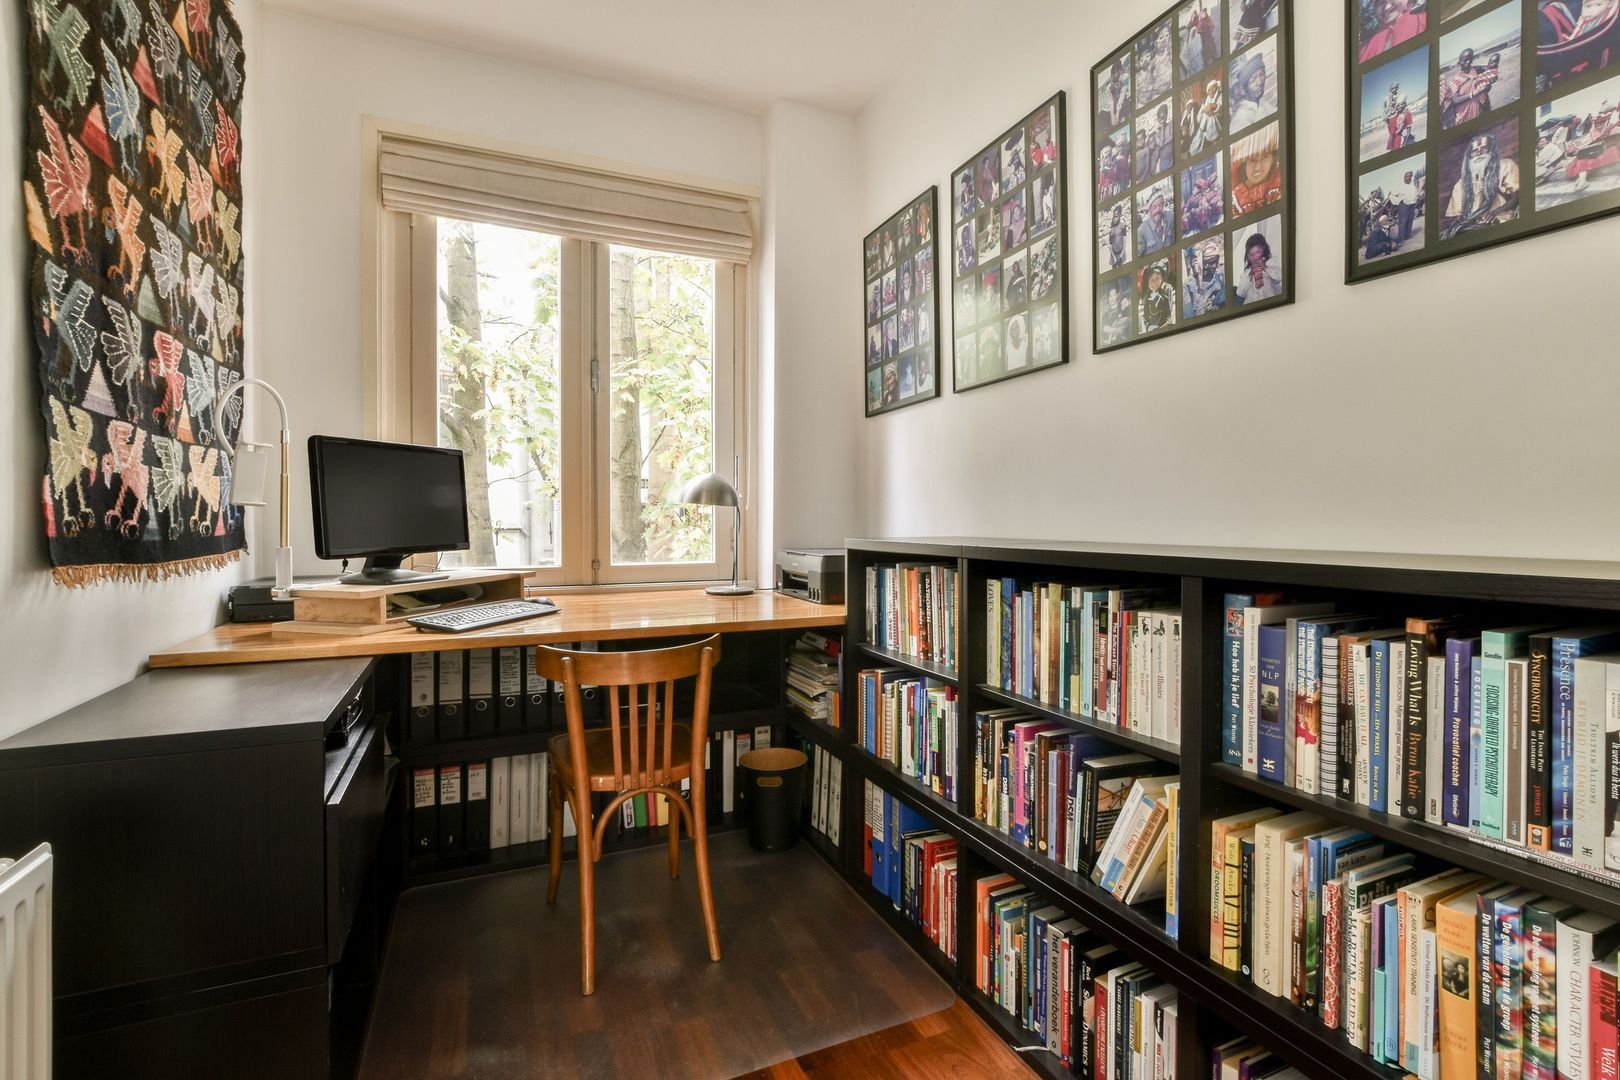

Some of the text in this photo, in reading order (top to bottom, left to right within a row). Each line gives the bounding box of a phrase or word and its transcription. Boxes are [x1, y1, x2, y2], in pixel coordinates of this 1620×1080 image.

[1230, 641, 1241, 708] Hoe heb ik je lief
[1262, 670, 1280, 680] NLP
[1531, 650, 1547, 724] SYNCHRONICITY
[1559, 642, 1576, 700] Presence
[1248, 665, 1256, 752] 50 Psychologie klassiekers
[1406, 640, 1422, 798] Loving What Is Byron Katie
[1577, 700, 1586, 746] BEVRIJD
[1452, 717, 1461, 786] Provocatief coachen
[1486, 684, 1498, 796] FOCUSING-ORIENTED PSYCHOTHERAPY
[1590, 722, 1598, 804] TSULTRIM ALLIONE
[1576, 763, 1586, 820] DEMONEN
[1136, 815, 1146, 829] Am
[1264, 834, 1272, 956] Jung Herinneringen dromen gedachten
[1349, 889, 1356, 902] DE
[1537, 858, 1578, 874] LEIDERSCHAP
[1581, 871, 1594, 880] EEN
[1594, 876, 1610, 885] REIS
[1566, 858, 1612, 878] GENERATIES
[1482, 914, 1492, 1004] De wetten van de stam
[1532, 925, 1542, 935] De
[1500, 922, 1512, 1030] De geheimen van de groep
[1600, 979, 1616, 1016] LIFE
[1530, 1014, 1540, 1048] systeem
[1569, 933, 1582, 1080] JOHNSON CHARACTER STYLES
[1601, 1047, 1616, 1076] Welk
